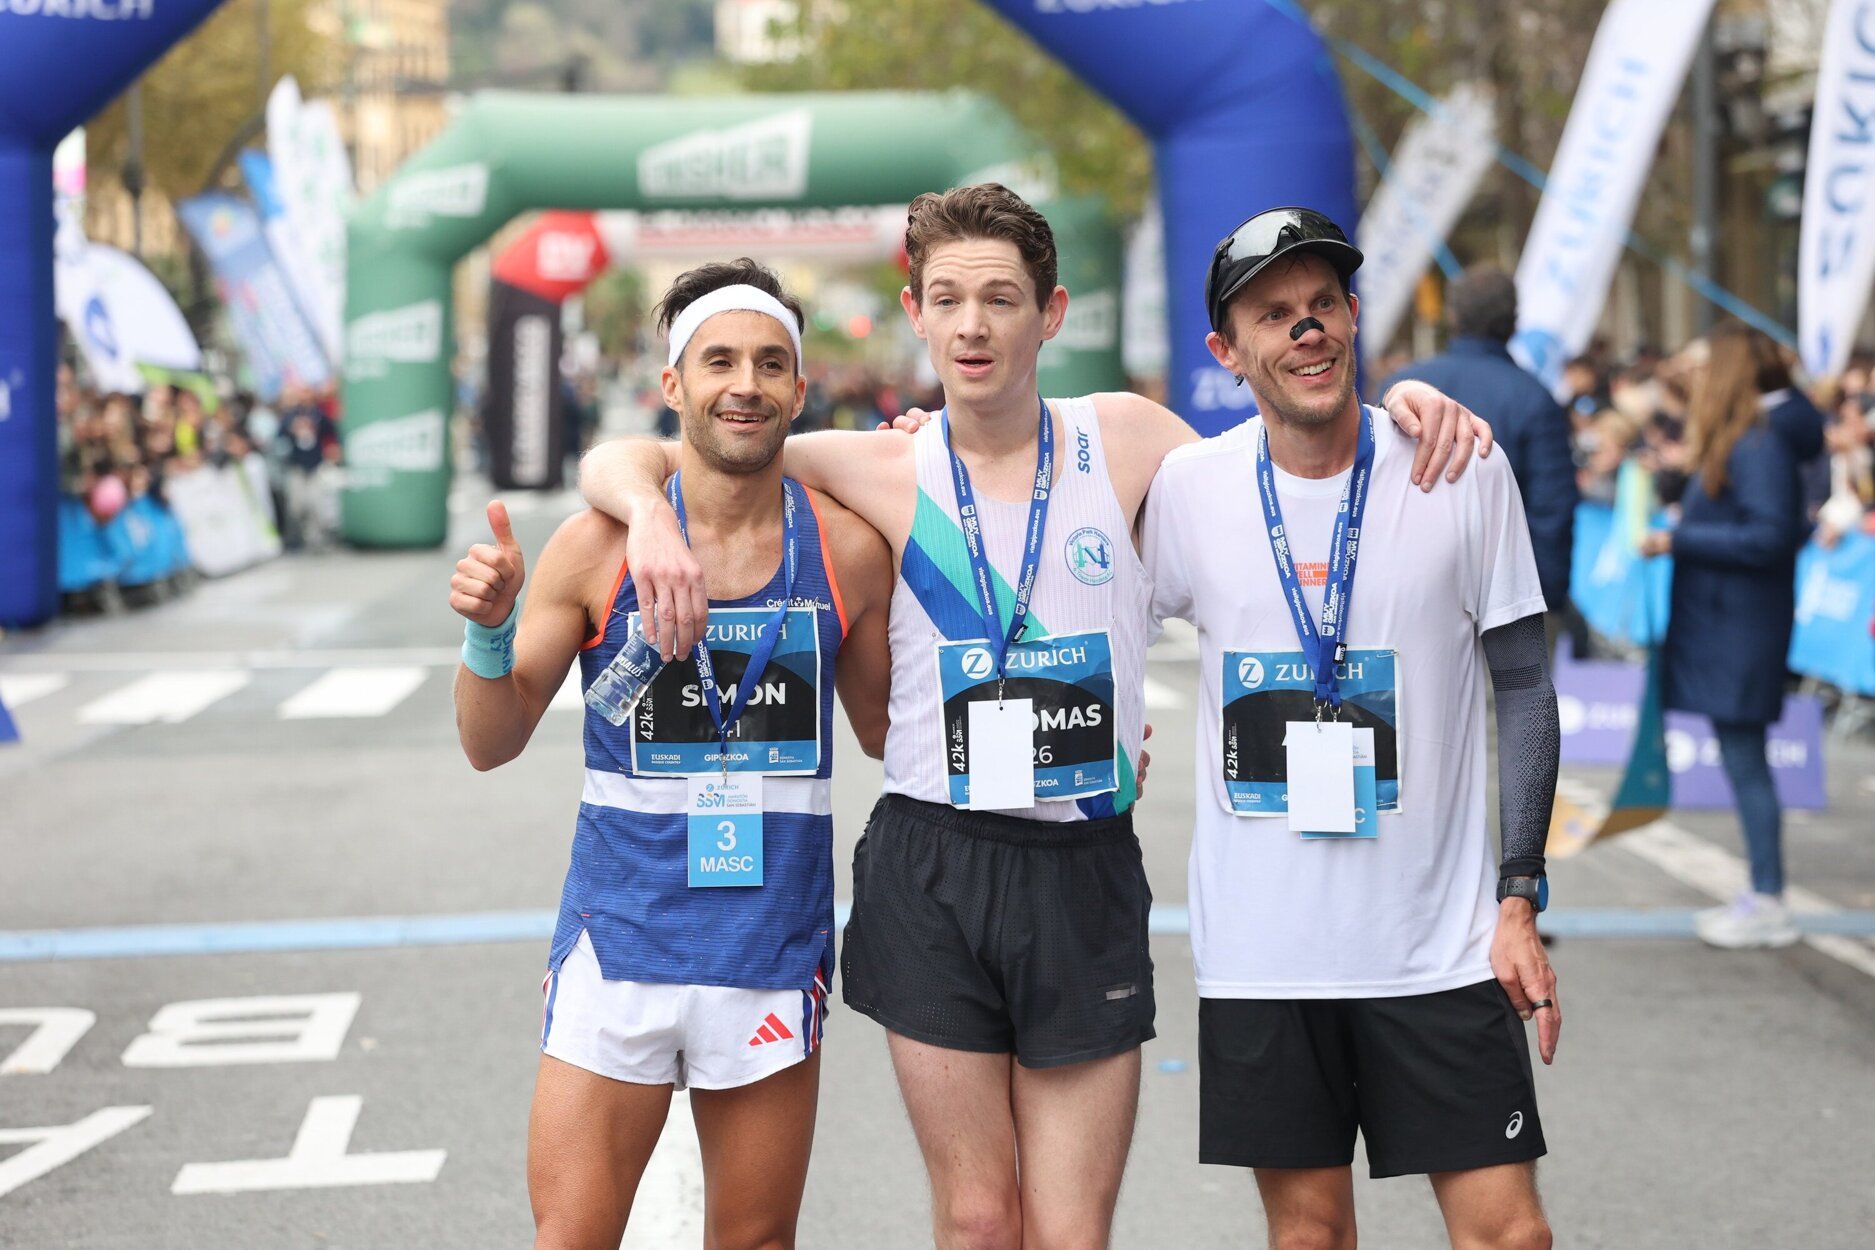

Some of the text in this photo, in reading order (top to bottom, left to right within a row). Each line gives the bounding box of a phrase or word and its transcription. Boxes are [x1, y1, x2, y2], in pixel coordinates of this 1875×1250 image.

[1077, 426, 1090, 473] soar
[1005, 645, 1087, 670] ZURICH
[1275, 662, 1363, 682] ZUCH
[639, 712, 654, 741] 42k
[704, 753, 749, 762] GIPZKOA
[950, 743, 966, 772] 42k
[1226, 749, 1239, 779] 42k
[717, 820, 737, 852] 3
[700, 855, 754, 873] MASC
